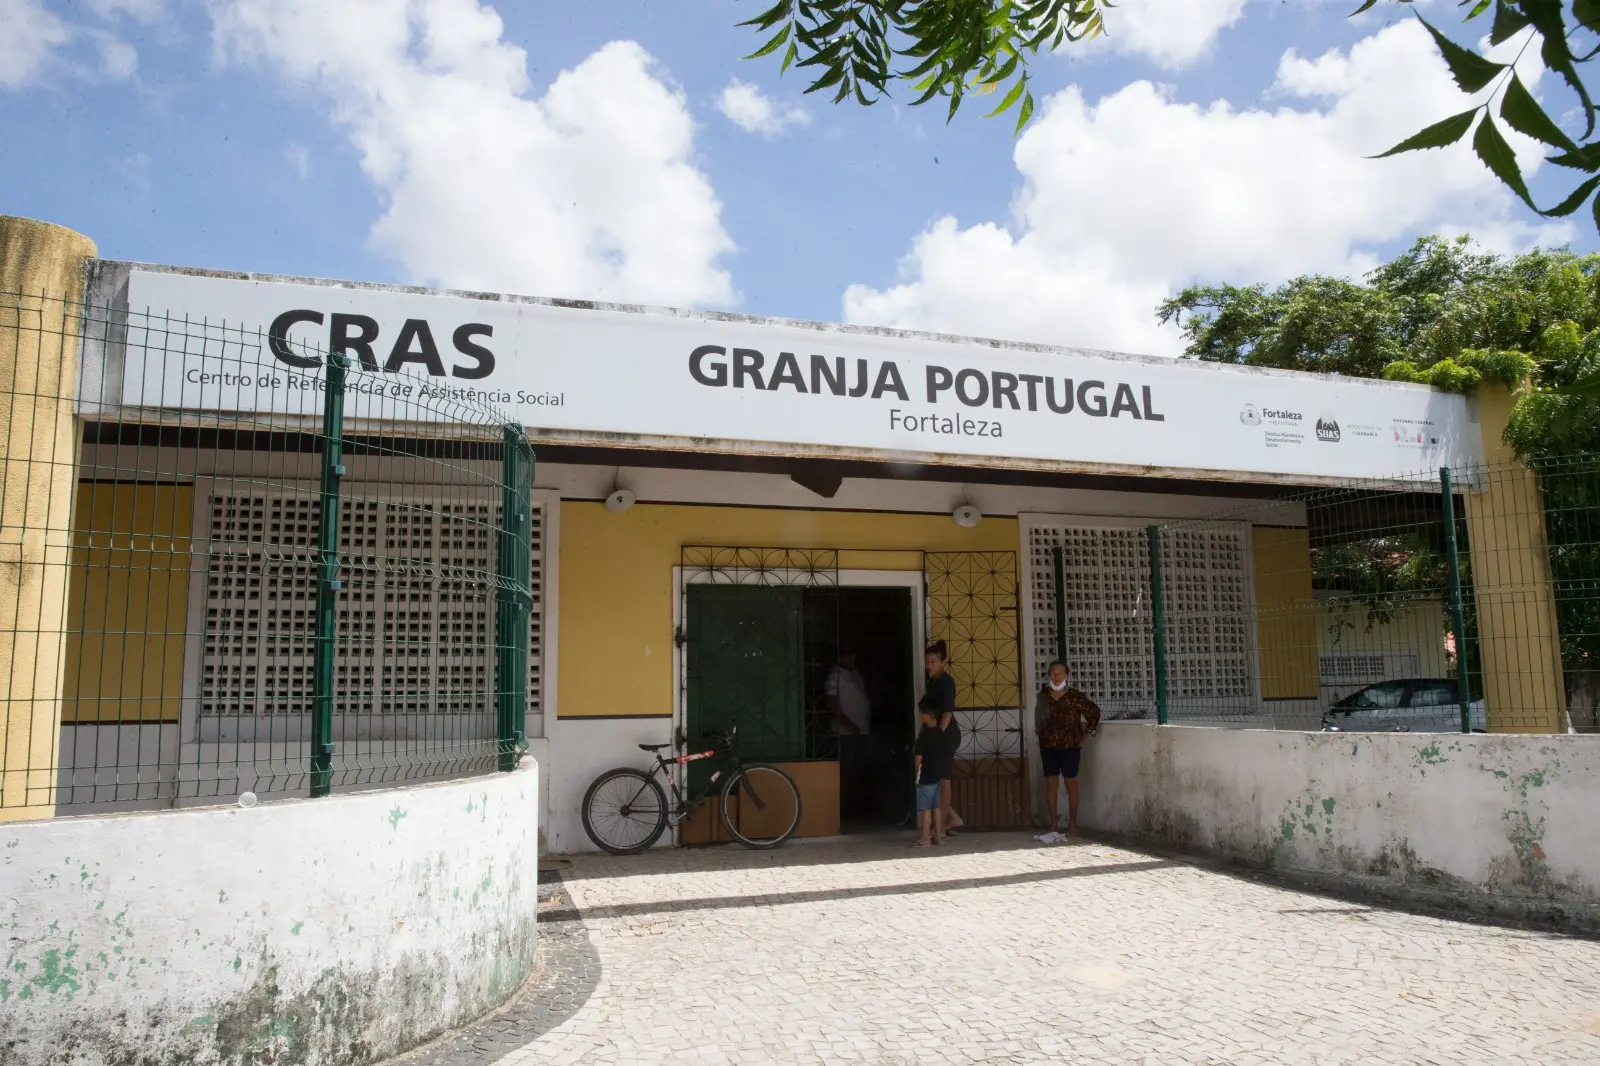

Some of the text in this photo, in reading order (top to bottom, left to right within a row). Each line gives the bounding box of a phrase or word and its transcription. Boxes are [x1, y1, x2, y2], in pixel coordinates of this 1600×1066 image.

[268, 308, 496, 380] CRAS
[187, 368, 564, 406] Centro de Refencia de Assistência Social
[688, 344, 1166, 422] GRANJA PORTUGAL
[889, 408, 1003, 438] Fortaleza
[1262, 408, 1303, 420] Fortaleza
[1317, 429, 1340, 439] SUAS
